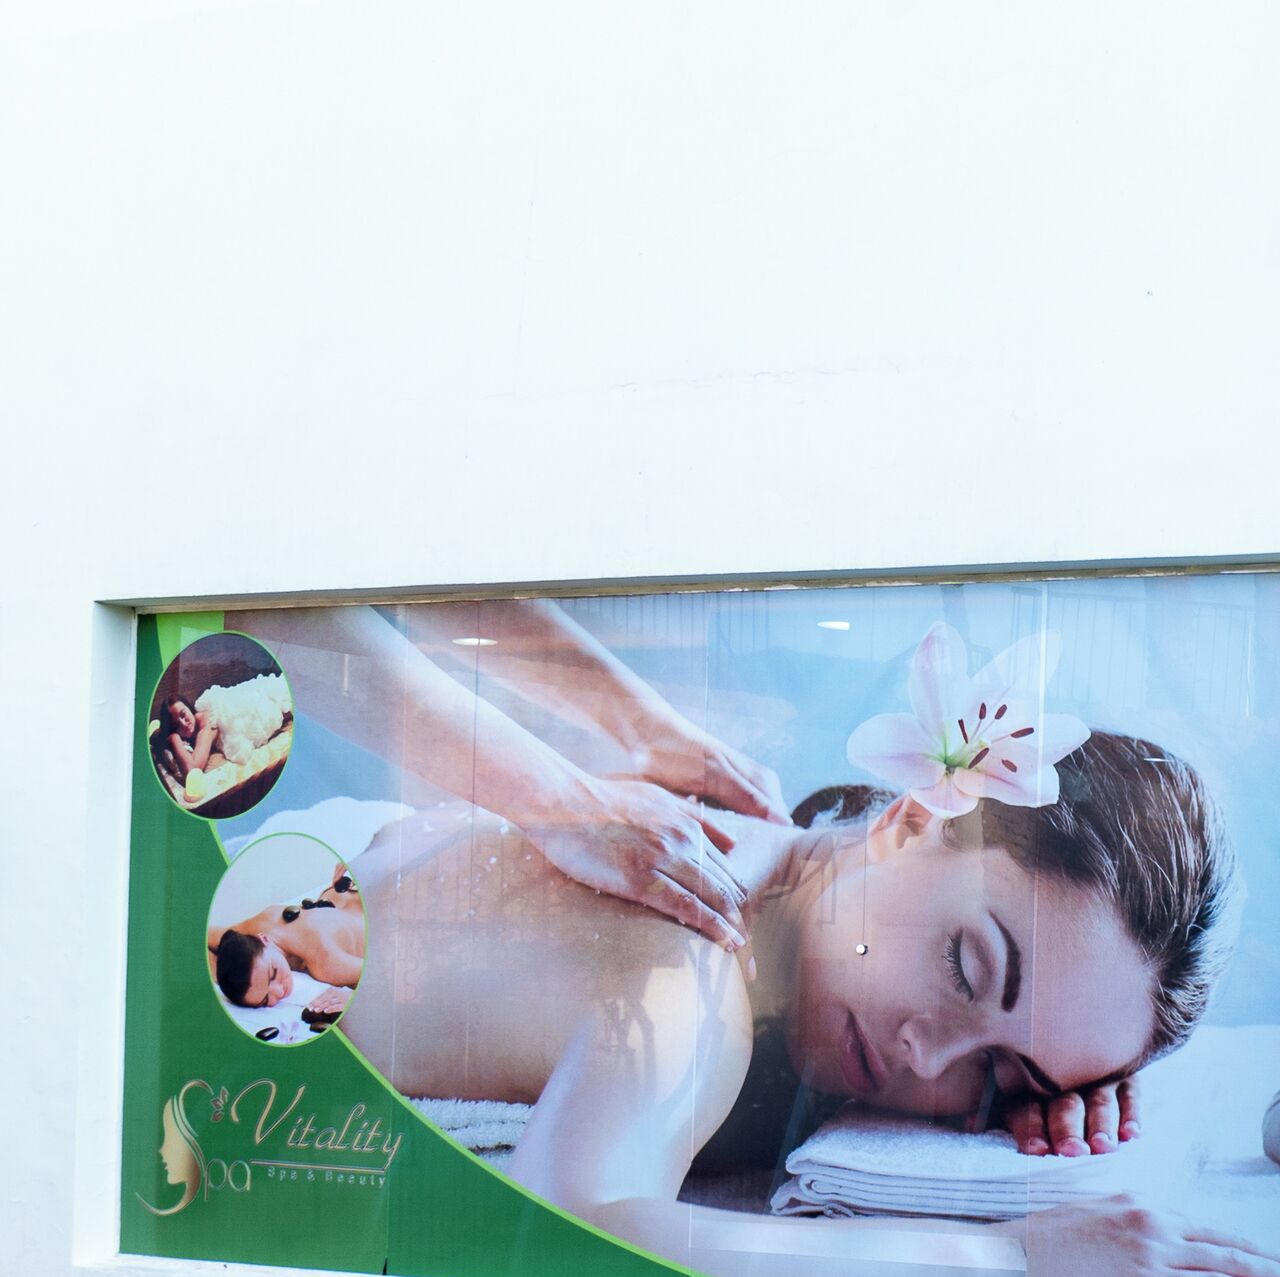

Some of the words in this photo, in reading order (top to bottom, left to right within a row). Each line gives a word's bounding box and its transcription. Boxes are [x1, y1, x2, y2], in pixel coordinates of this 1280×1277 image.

[230, 1078, 405, 1170] Vitality
[267, 1166, 298, 1182] Spa
[306, 1168, 316, 1182] &
[324, 1169, 387, 1188] Beauty
